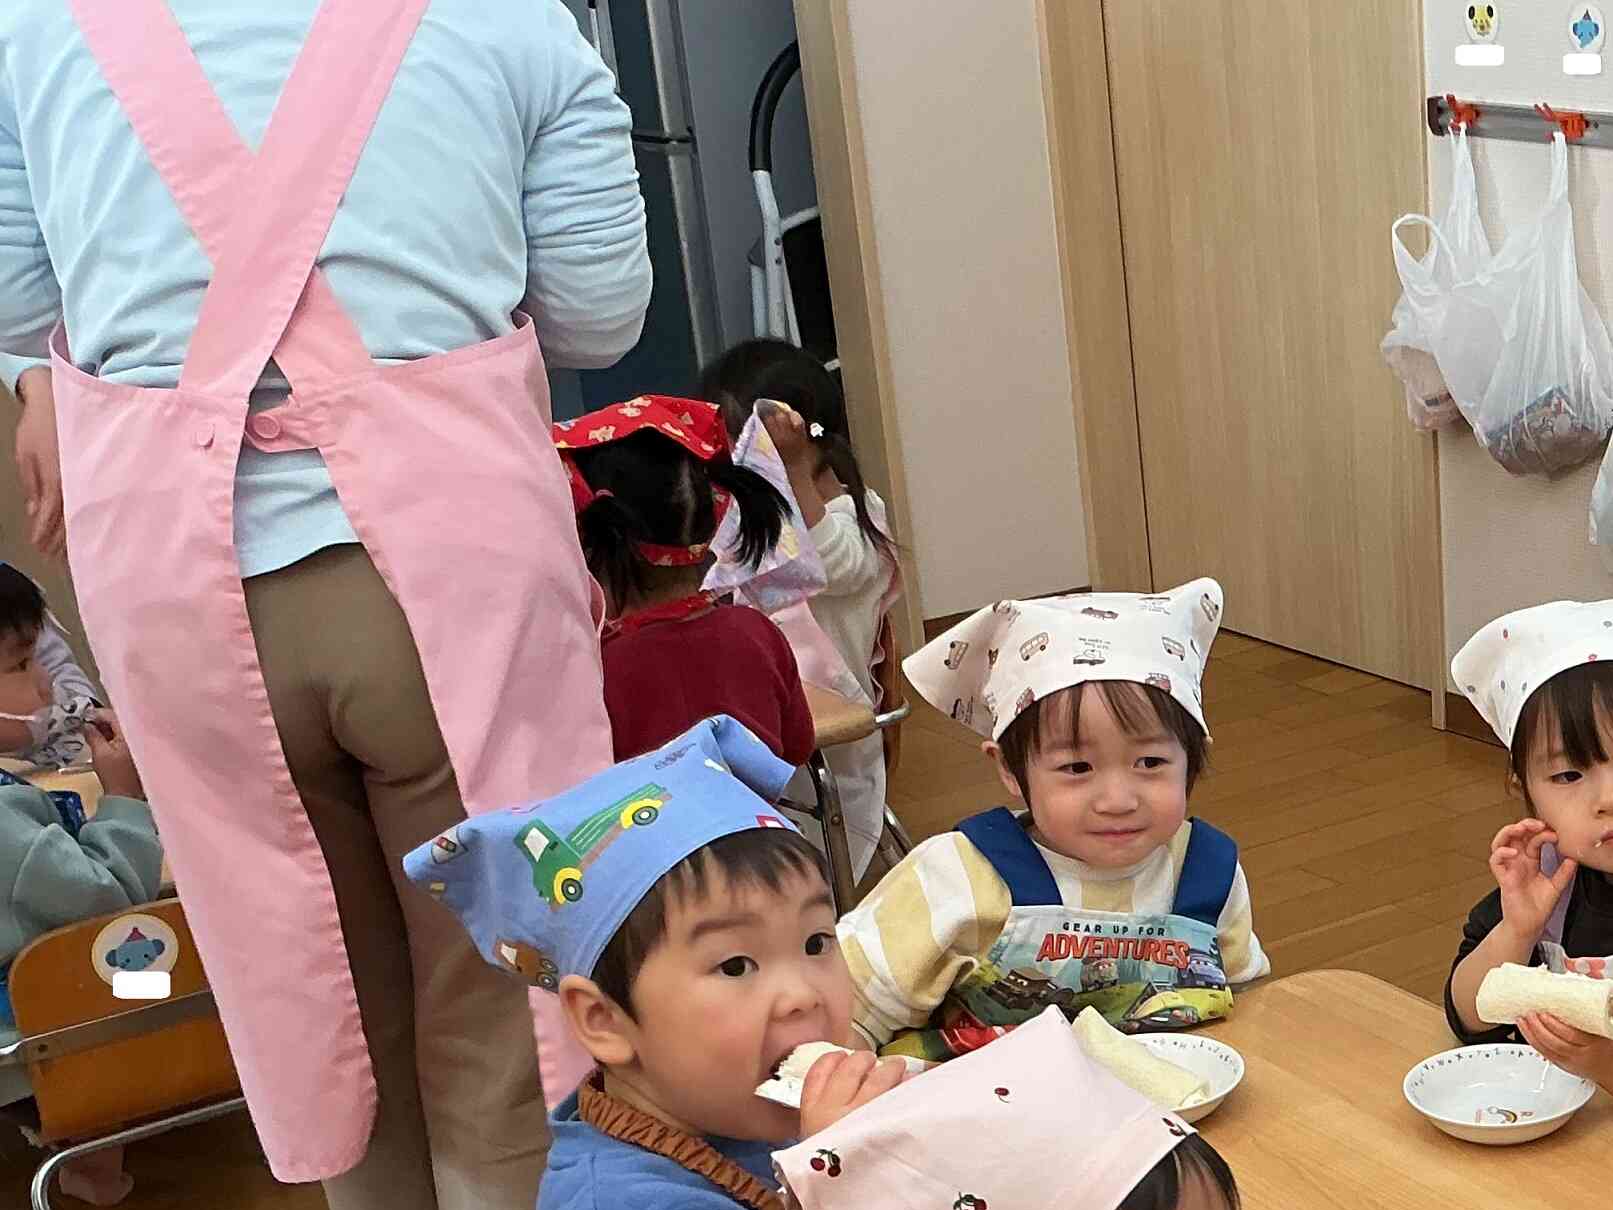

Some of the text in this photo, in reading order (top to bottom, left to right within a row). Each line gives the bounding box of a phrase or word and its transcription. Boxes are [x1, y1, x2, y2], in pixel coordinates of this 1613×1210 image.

[1062, 921, 1166, 937] GEAR UP FOR
[1036, 933, 1191, 969] ADVENTURES
